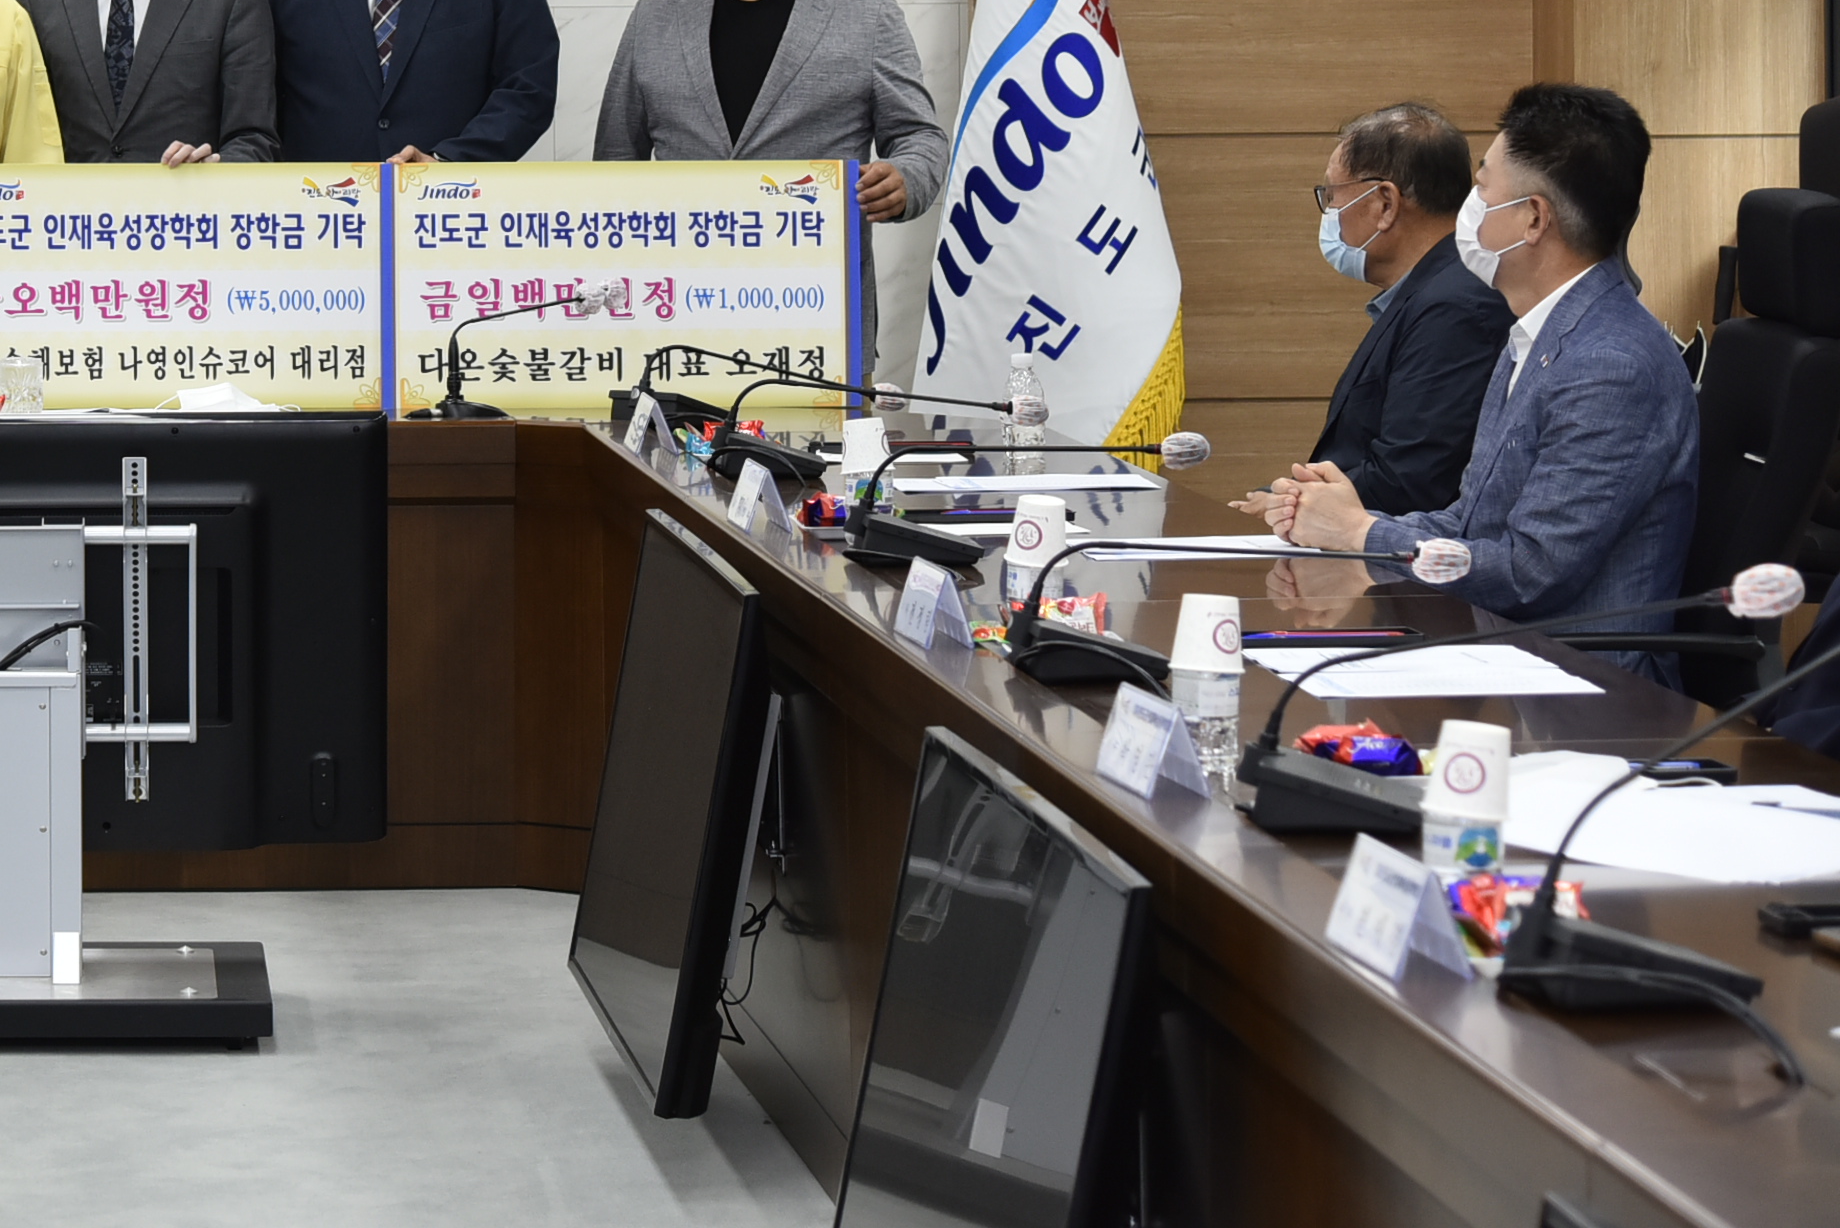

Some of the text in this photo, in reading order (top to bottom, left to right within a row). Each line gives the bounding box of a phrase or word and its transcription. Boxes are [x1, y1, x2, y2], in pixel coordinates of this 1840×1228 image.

[417, 184, 470, 201] Jindo
[926, 32, 1105, 376] Jindo
[42, 213, 218, 251] 인재육성장학회
[230, 213, 305, 250] 장학금
[316, 213, 366, 248] 기탁
[413, 210, 824, 249] 진도군 인재육성장학회 장학금 기탁
[116, 345, 275, 381] 나영인슈코어
[288, 344, 365, 380] 대리점
[415, 346, 824, 382] 다온숯불갈비 대표 오재정
